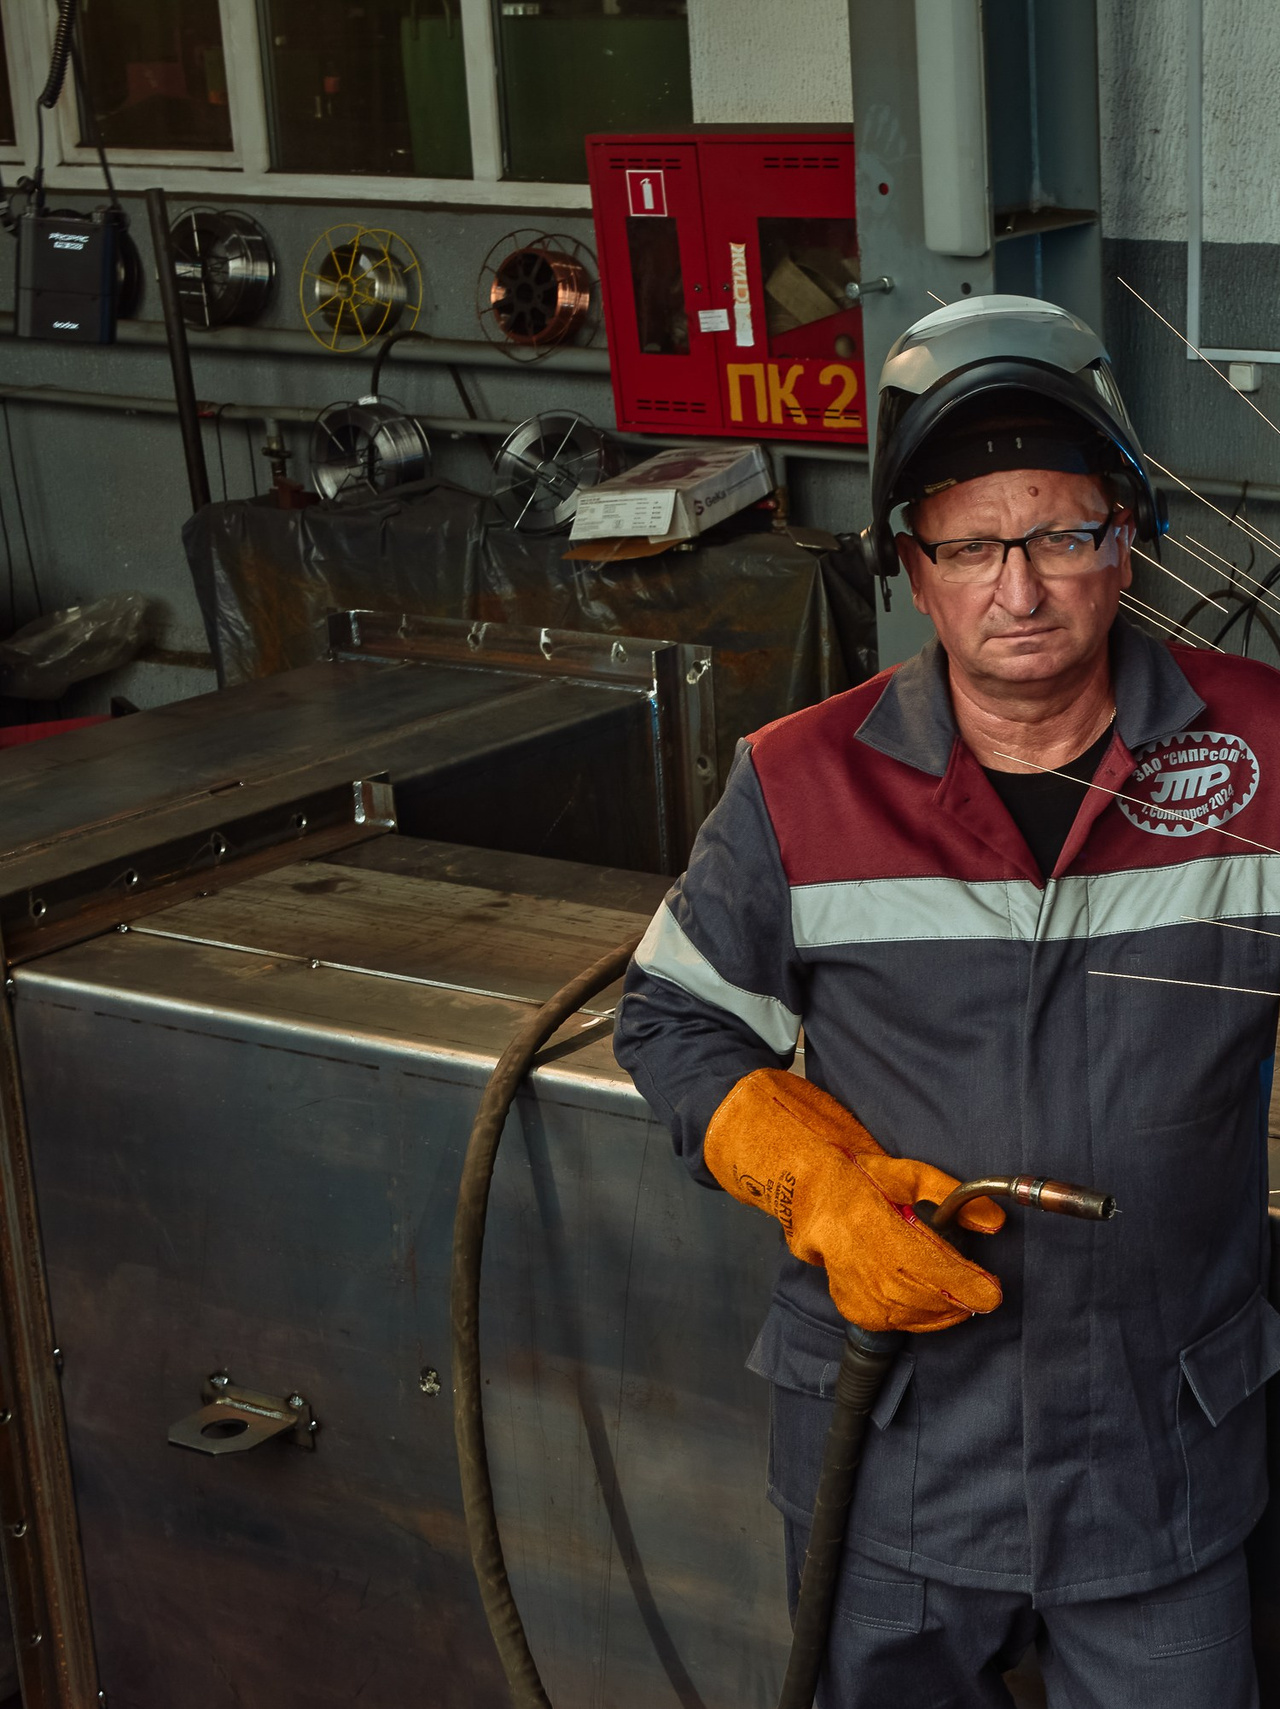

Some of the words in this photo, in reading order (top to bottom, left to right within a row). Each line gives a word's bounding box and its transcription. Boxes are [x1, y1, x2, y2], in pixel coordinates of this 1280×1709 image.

[726, 363, 808, 425] ПК
[818, 364, 862, 428] 2
[1133, 759, 1162, 782] ЗАО
[1208, 783, 1235, 811] 2024
